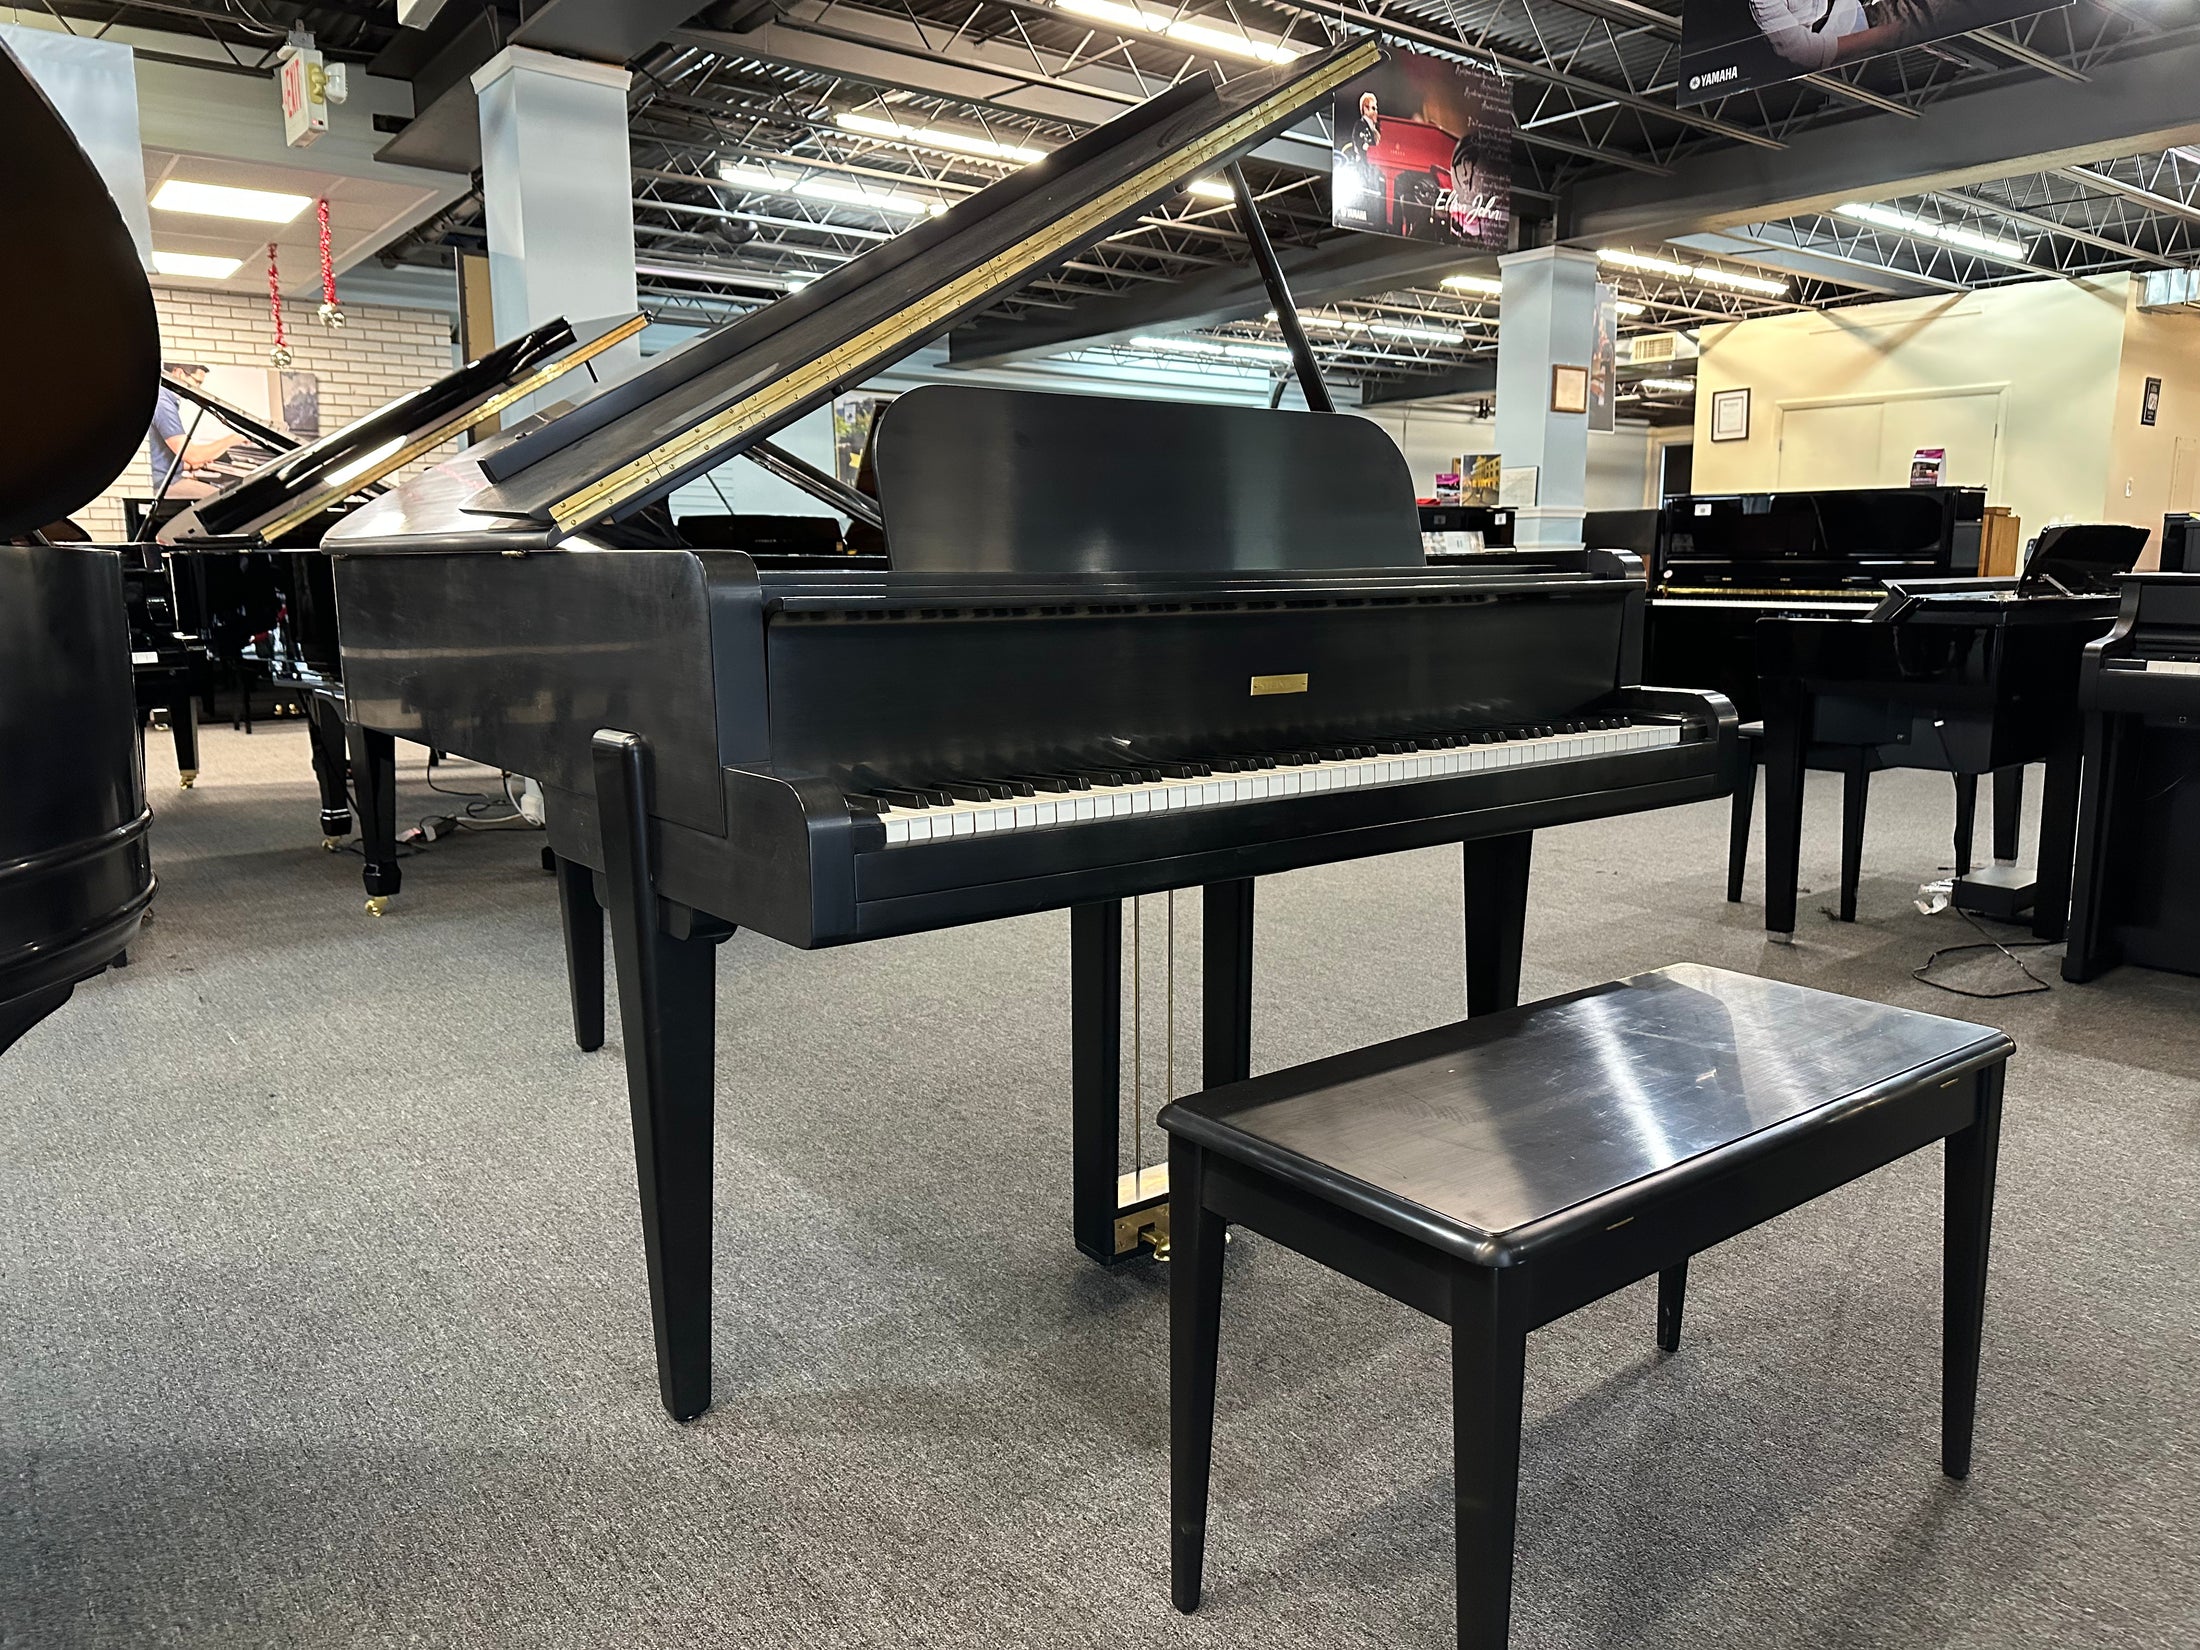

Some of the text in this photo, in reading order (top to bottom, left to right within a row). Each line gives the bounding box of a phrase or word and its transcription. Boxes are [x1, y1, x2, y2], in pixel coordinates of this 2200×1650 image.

[285, 58, 302, 118] EXIT
[1701, 66, 1738, 87] YAMAHA
[1434, 188, 1502, 225] Elton John
